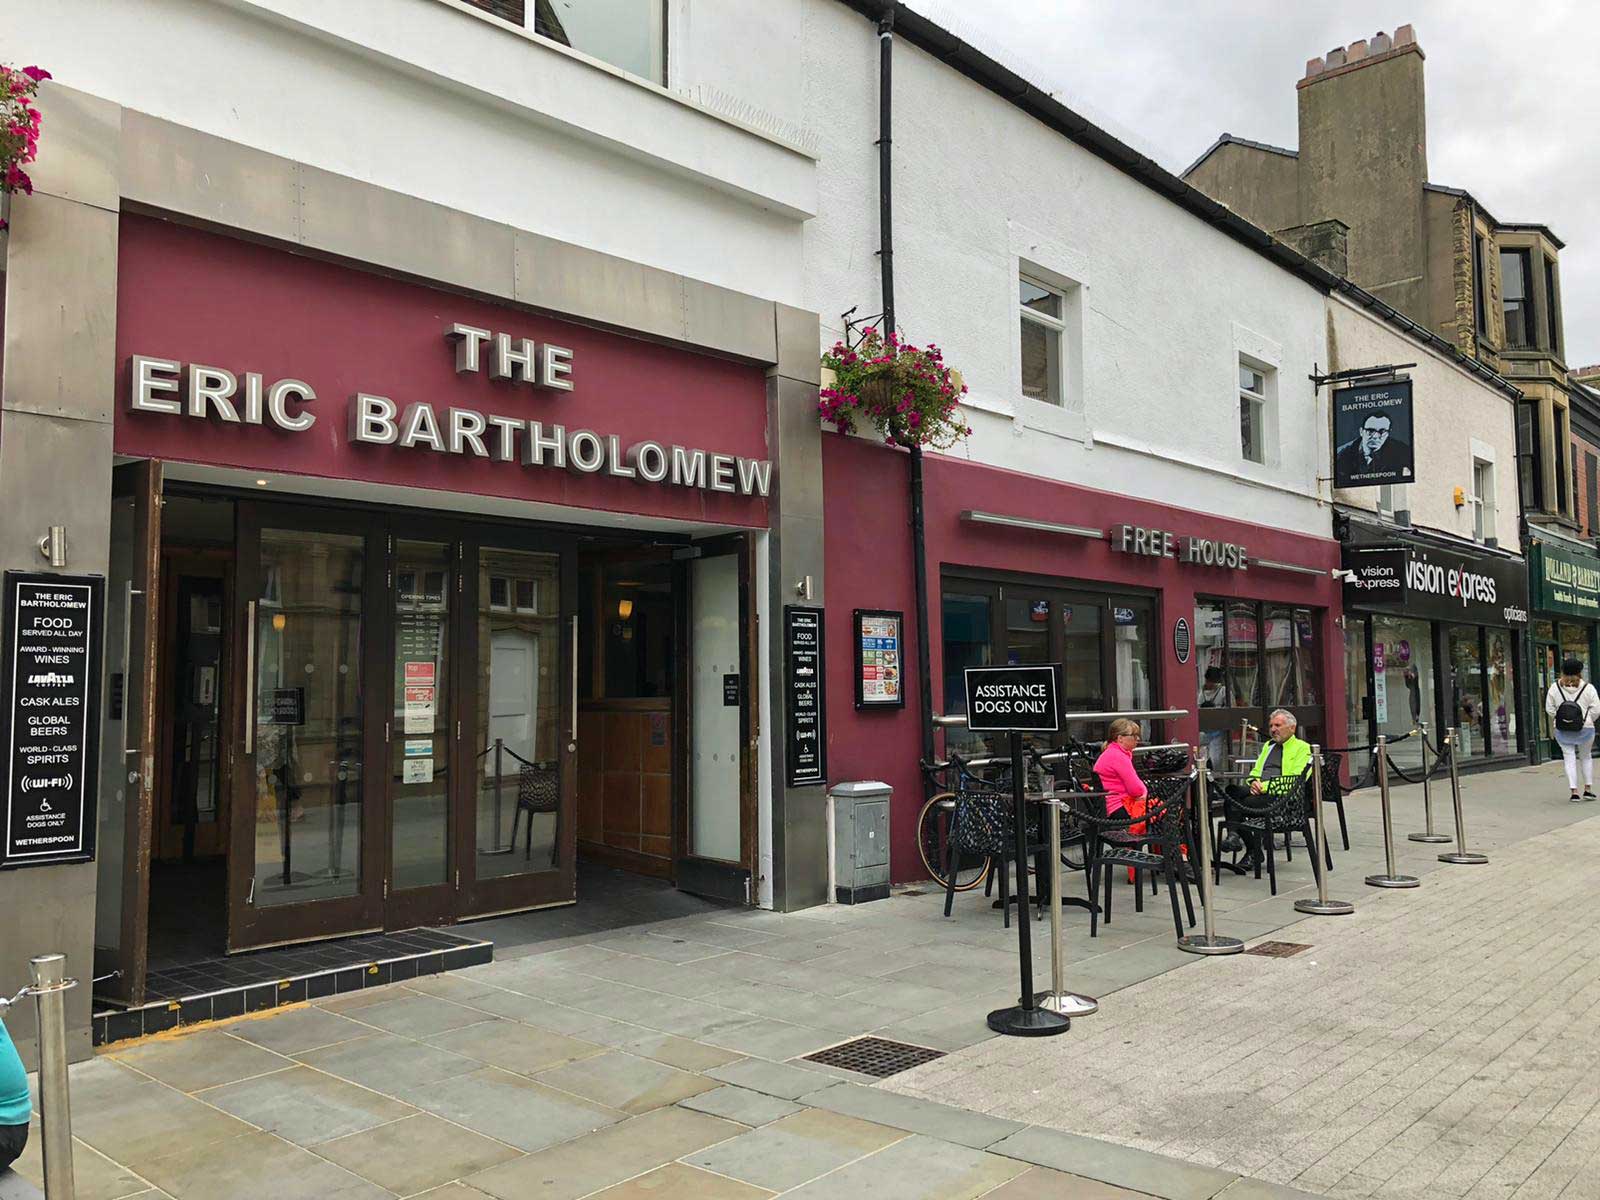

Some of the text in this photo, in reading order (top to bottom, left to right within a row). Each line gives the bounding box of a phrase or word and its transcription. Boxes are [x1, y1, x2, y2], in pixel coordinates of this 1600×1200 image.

[450, 323, 575, 392] THE
[1371, 392, 1389, 400] ERIC
[1342, 398, 1402, 411] BARTHOLOMEW
[130, 354, 773, 496] ERIC BARTHOLOMEW
[1350, 472, 1396, 480] WETHERSPOON
[1120, 525, 1248, 570] FREE HOUSE
[1361, 565, 1394, 576] vision
[1355, 579, 1400, 590] express
[1405, 551, 1497, 607] vision express
[20, 600, 87, 608] BARTHOLOMEW
[1504, 605, 1527, 623] opticians
[34, 617, 73, 628] FOOD
[34, 655, 70, 664] WINES
[975, 684, 1046, 697] ASSISTANCE
[20, 697, 79, 706] CASK ALES
[975, 700, 1047, 713] DOGS ONLY
[28, 716, 71, 725] GLOBAL
[31, 726, 67, 736] BEERS
[27, 754, 69, 764] SPIRITS
[26, 813, 66, 821] ASSISTANCE
[15, 835, 74, 846] WETHERSPOON
